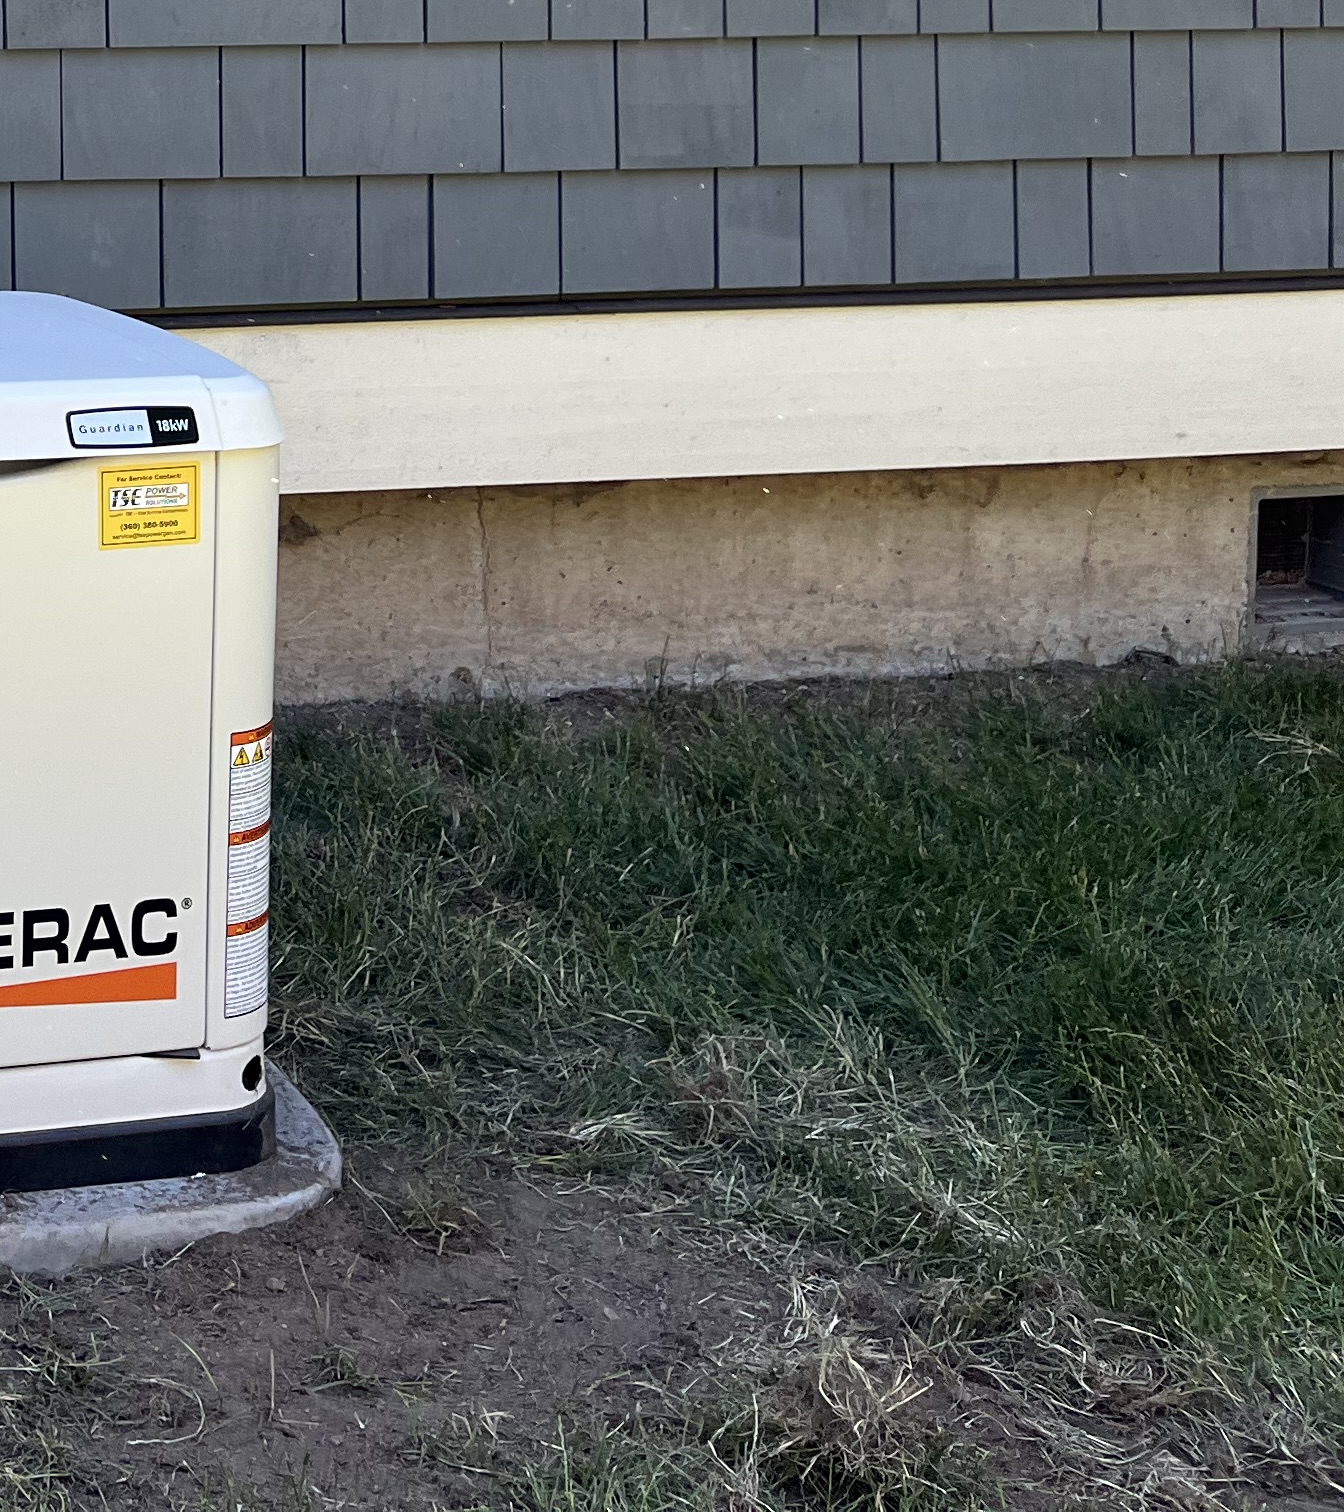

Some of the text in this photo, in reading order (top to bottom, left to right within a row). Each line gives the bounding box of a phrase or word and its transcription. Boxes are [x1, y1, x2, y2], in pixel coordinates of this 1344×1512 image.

[78, 418, 190, 434] Guardian 18kW
[111, 486, 179, 508] TSE POWER
